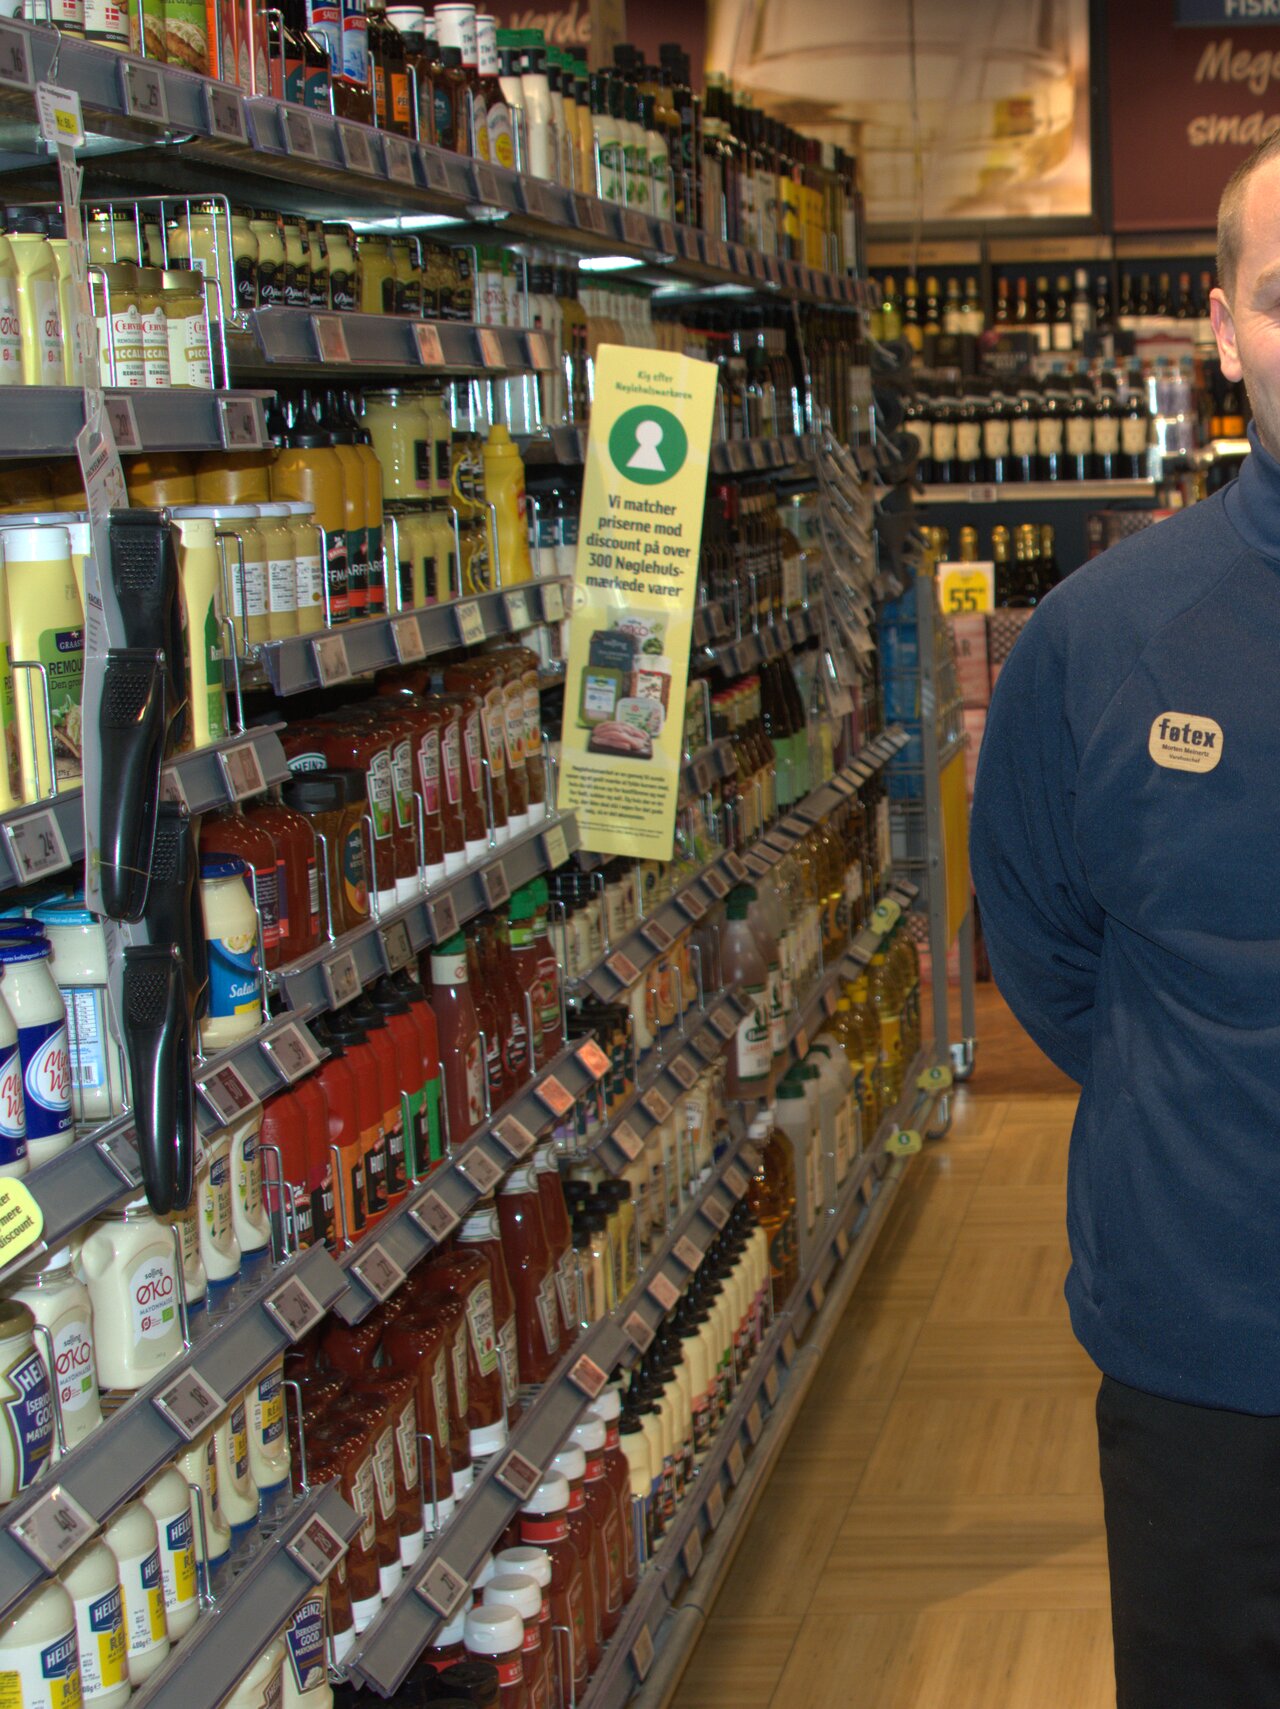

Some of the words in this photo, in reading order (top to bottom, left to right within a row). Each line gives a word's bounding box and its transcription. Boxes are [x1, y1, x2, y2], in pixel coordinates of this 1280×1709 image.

[608, 494, 621, 508] Vi
[624, 499, 677, 516] matcher
[598, 516, 651, 534] priserne
[654, 522, 683, 537] mod
[586, 533, 641, 553] discount
[643, 540, 660, 557] på
[663, 547, 691, 558] over
[588, 553, 612, 568] 300
[615, 556, 685, 578] Nøglehuls-
[585, 575, 650, 593] mærkede
[649, 585, 684, 598] varer
[949, 589, 978, 613] 55
[1158, 718, 1216, 748] føtex
[1162, 743, 1183, 753] Morten
[1184, 747, 1210, 758] Meinertz
[144, 1266, 163, 1281] salling
[136, 1275, 173, 1305] ØKO
[63, 1333, 82, 1348] salling
[55, 1341, 91, 1375] ØKO
[294, 1602, 321, 1623] HEINZ
[300, 1630, 320, 1646] GOOD
